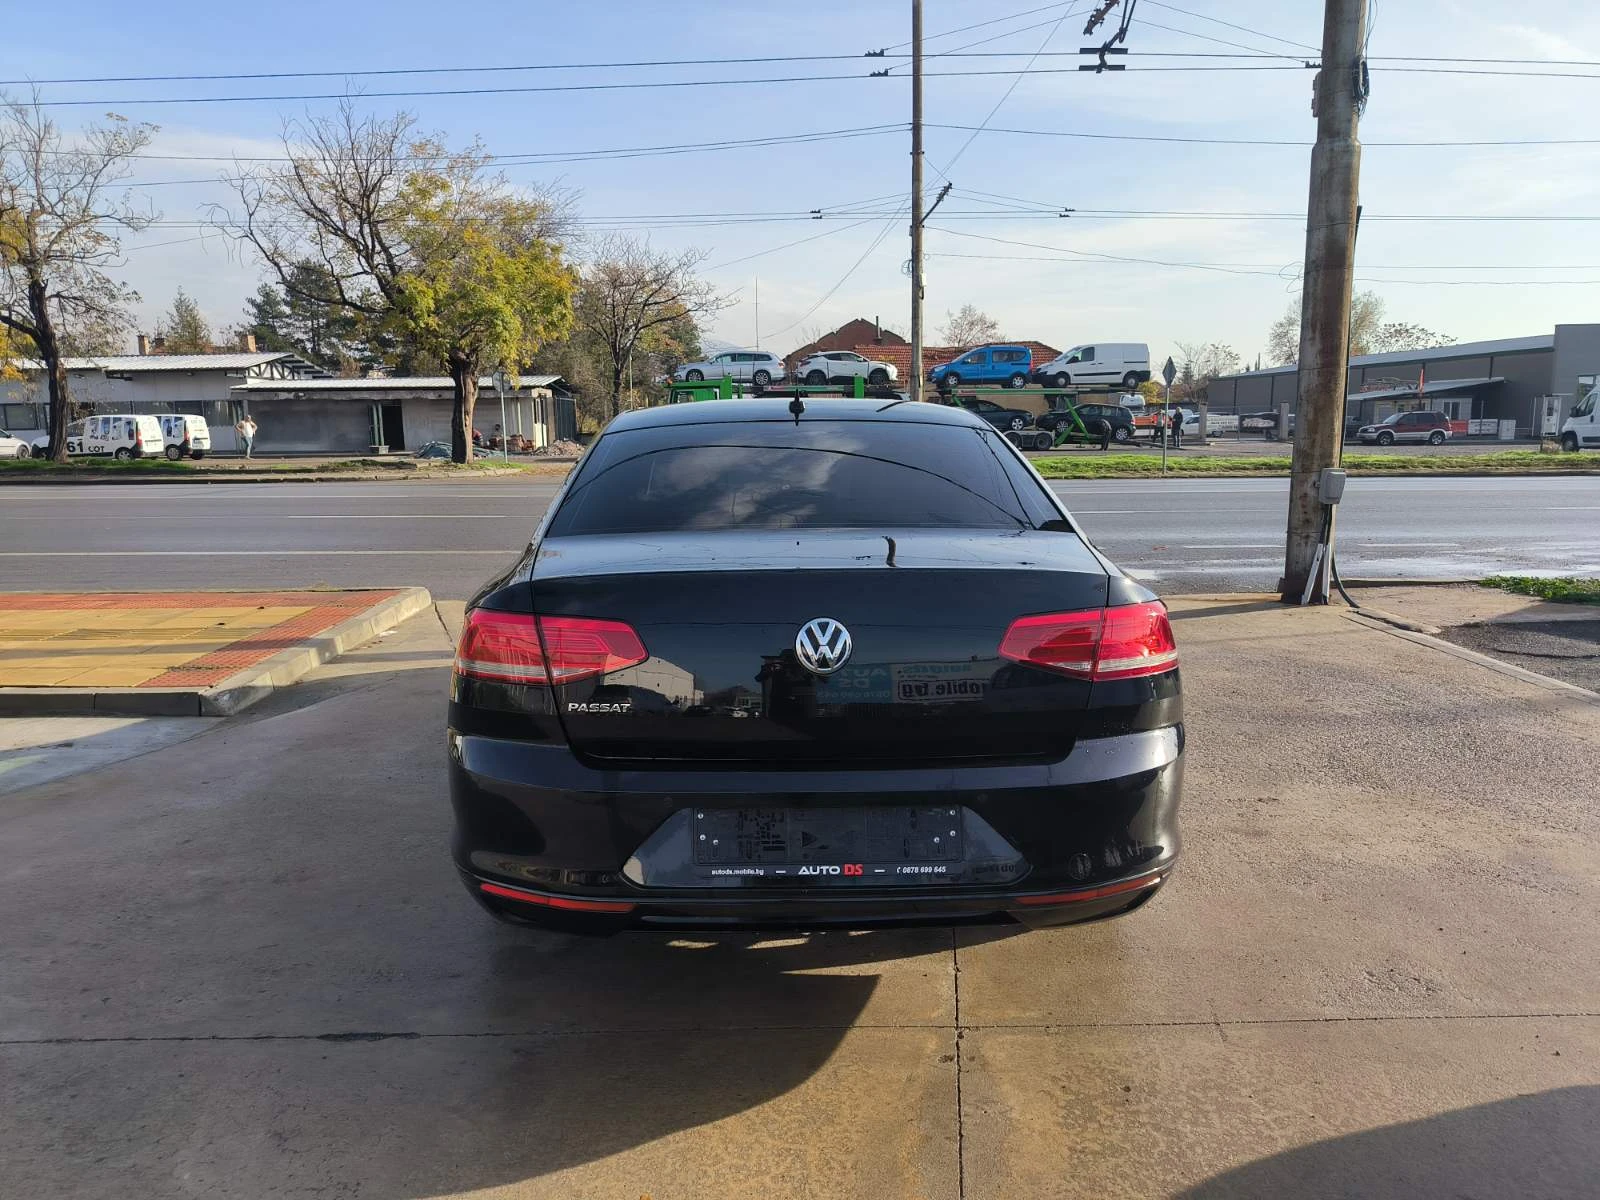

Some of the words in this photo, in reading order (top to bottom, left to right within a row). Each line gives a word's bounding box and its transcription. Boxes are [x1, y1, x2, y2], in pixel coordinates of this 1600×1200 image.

[568, 702, 631, 713] PASSAT
[798, 865, 841, 875] AUTO
[843, 863, 864, 876] DS
